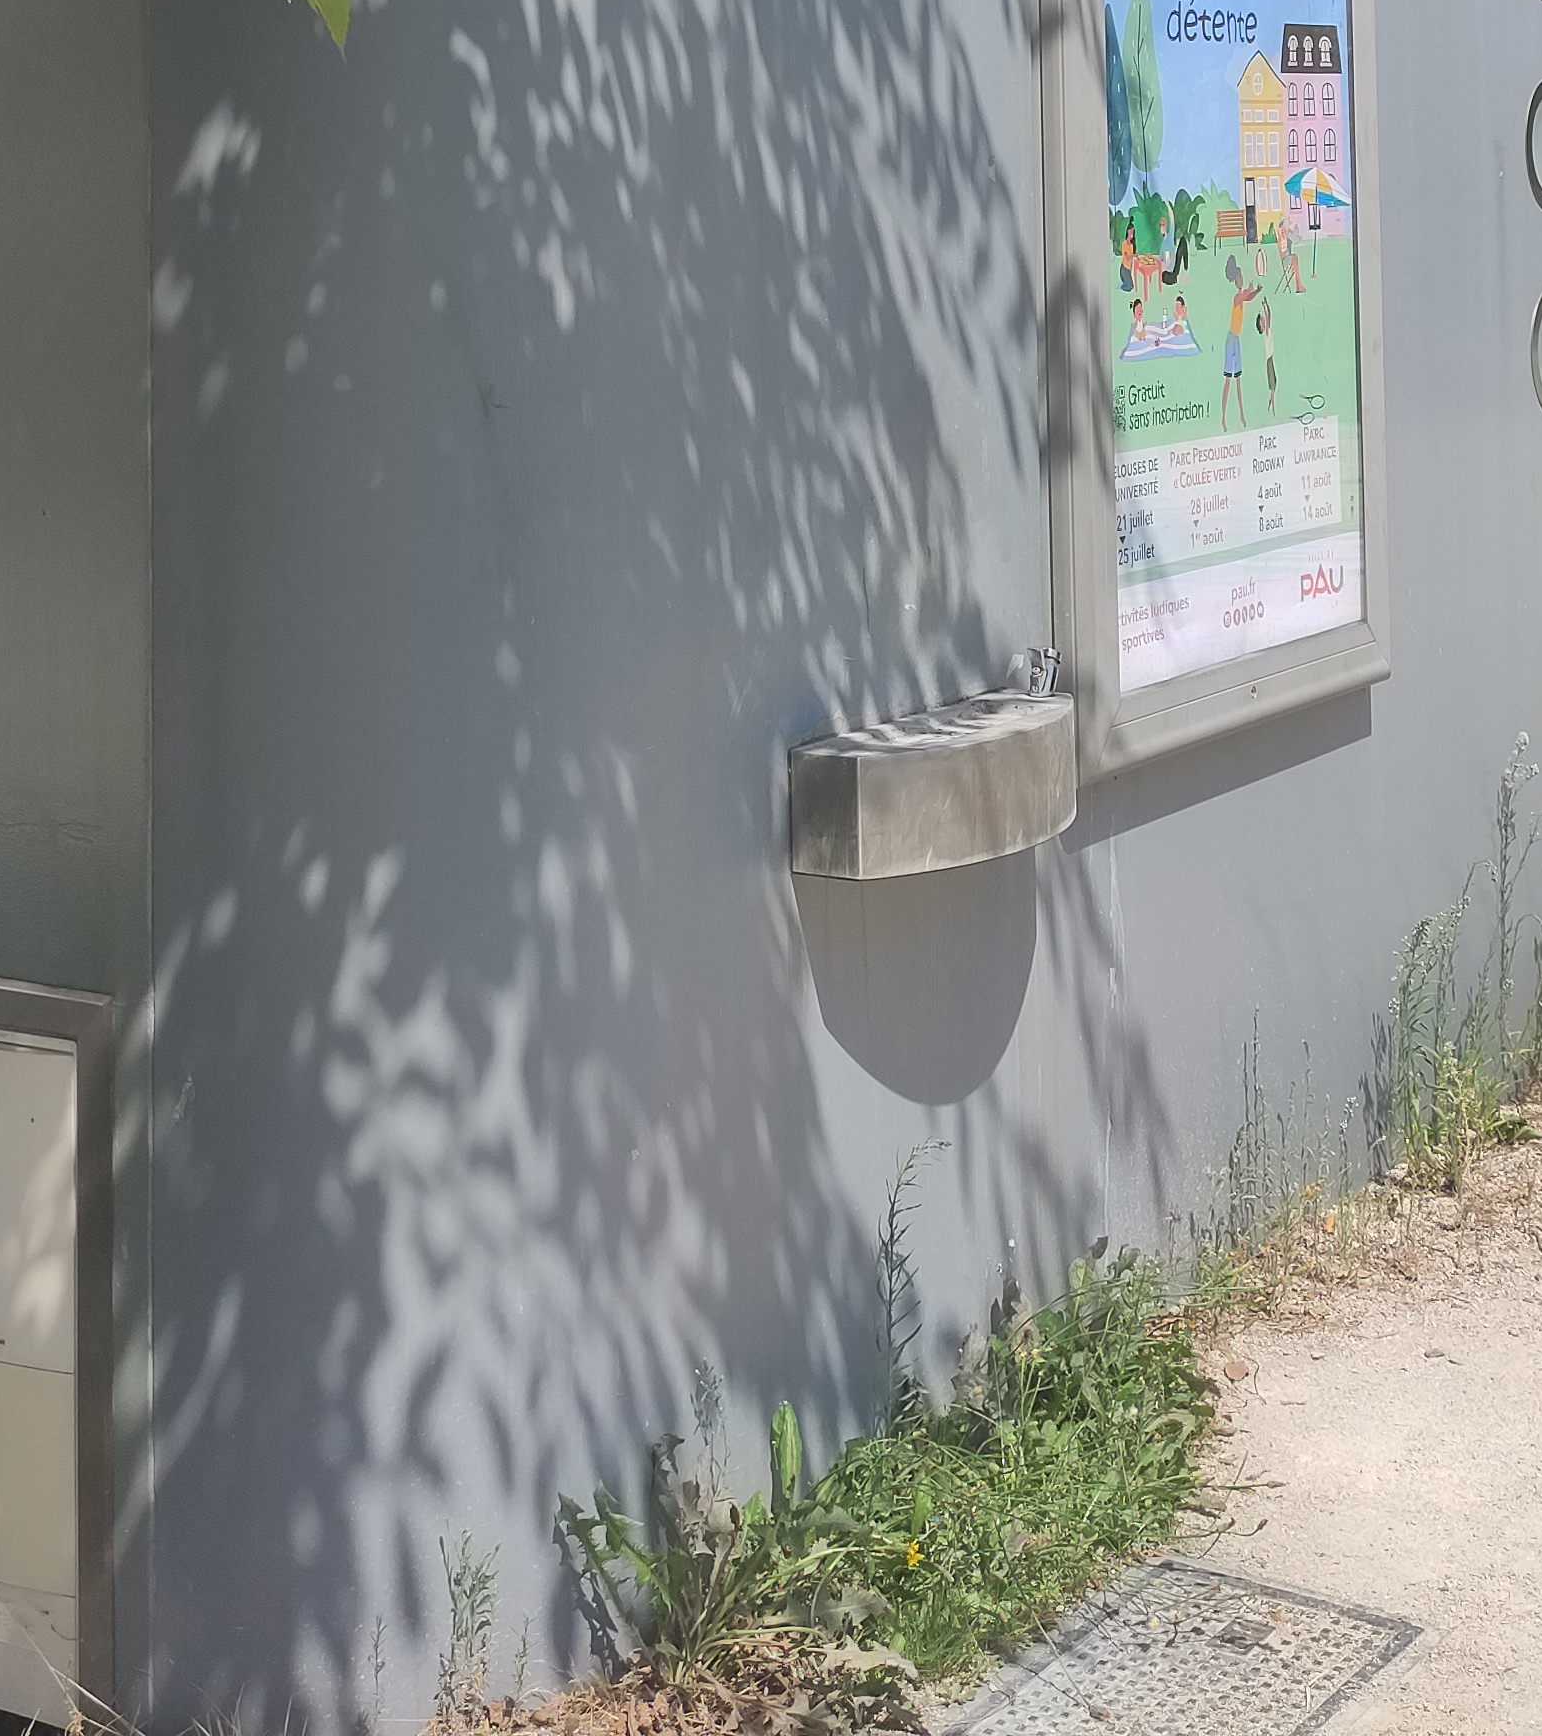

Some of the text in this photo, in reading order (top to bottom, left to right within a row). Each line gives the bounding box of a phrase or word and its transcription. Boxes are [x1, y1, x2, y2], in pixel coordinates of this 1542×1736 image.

[1128, 379, 1166, 406] Gratuit
[1129, 411, 1150, 430] sans
[1152, 401, 1204, 425] inscription
[1259, 436, 1277, 452] PARC
[1303, 427, 1325, 442] PARC
[1114, 458, 1158, 479] ELOUSES DE
[1169, 451, 1191, 468] PARC
[1252, 456, 1285, 474] RIDGWAY
[1257, 486, 1263, 499] 4
[1301, 474, 1311, 490] 11
[1191, 494, 1228, 518] 28 juillet
[1303, 505, 1313, 521] 14
[1116, 509, 1154, 534] 21 juillet
[1258, 517, 1264, 532] 8
[1118, 543, 1155, 567] 25 juillet
[1231, 577, 1256, 606] pau.fr
[1300, 563, 1344, 602] PAU
[1118, 597, 1190, 627] tivités ludiques
[1121, 628, 1165, 654] sportives
